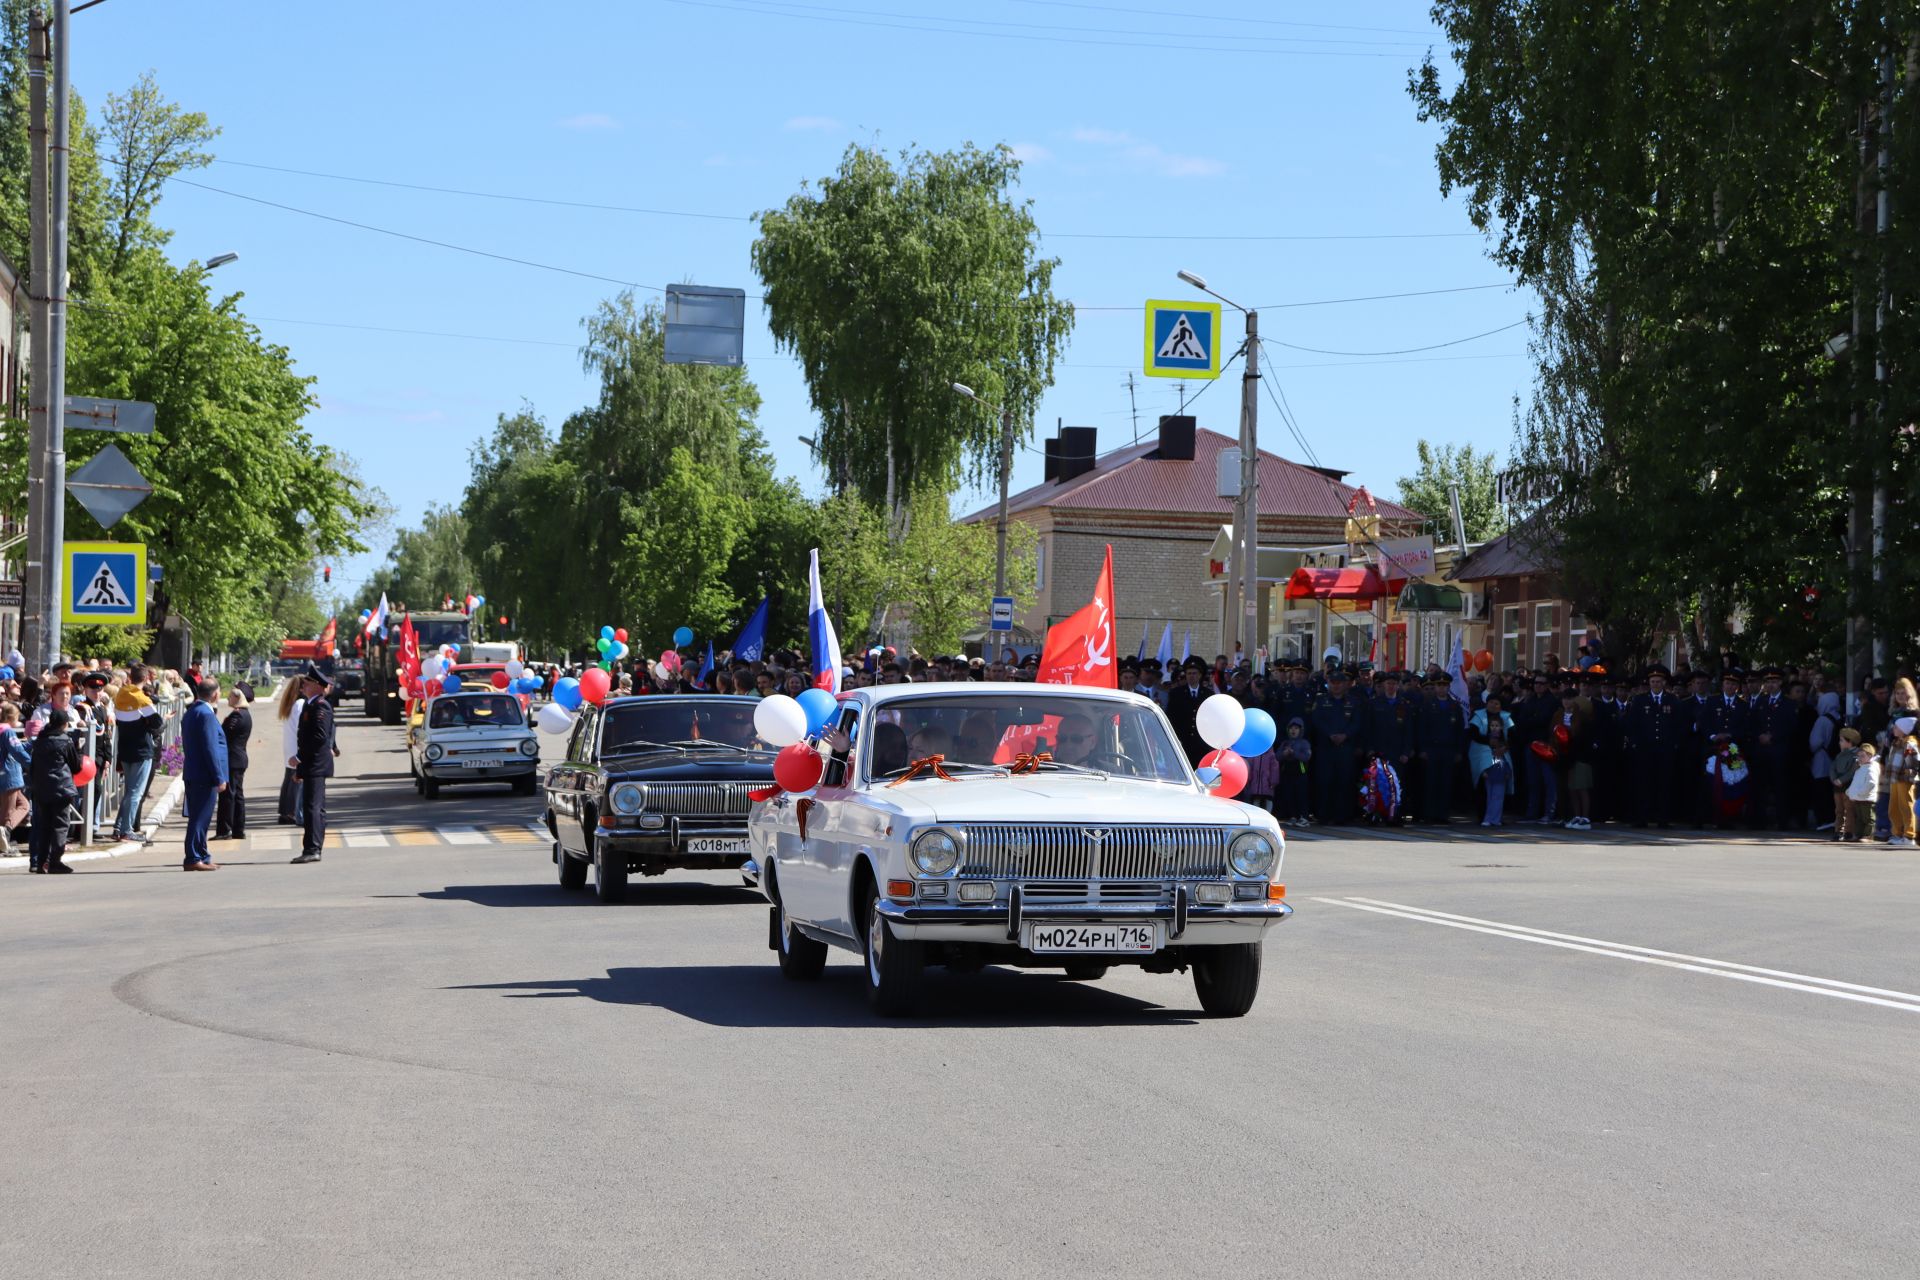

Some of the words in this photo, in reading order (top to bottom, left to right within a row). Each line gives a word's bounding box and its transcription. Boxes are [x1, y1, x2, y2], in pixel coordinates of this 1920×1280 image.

[693, 839, 738, 851] Х018МТ
[1039, 928, 1115, 948] М024РН
[1119, 928, 1148, 942] 716
